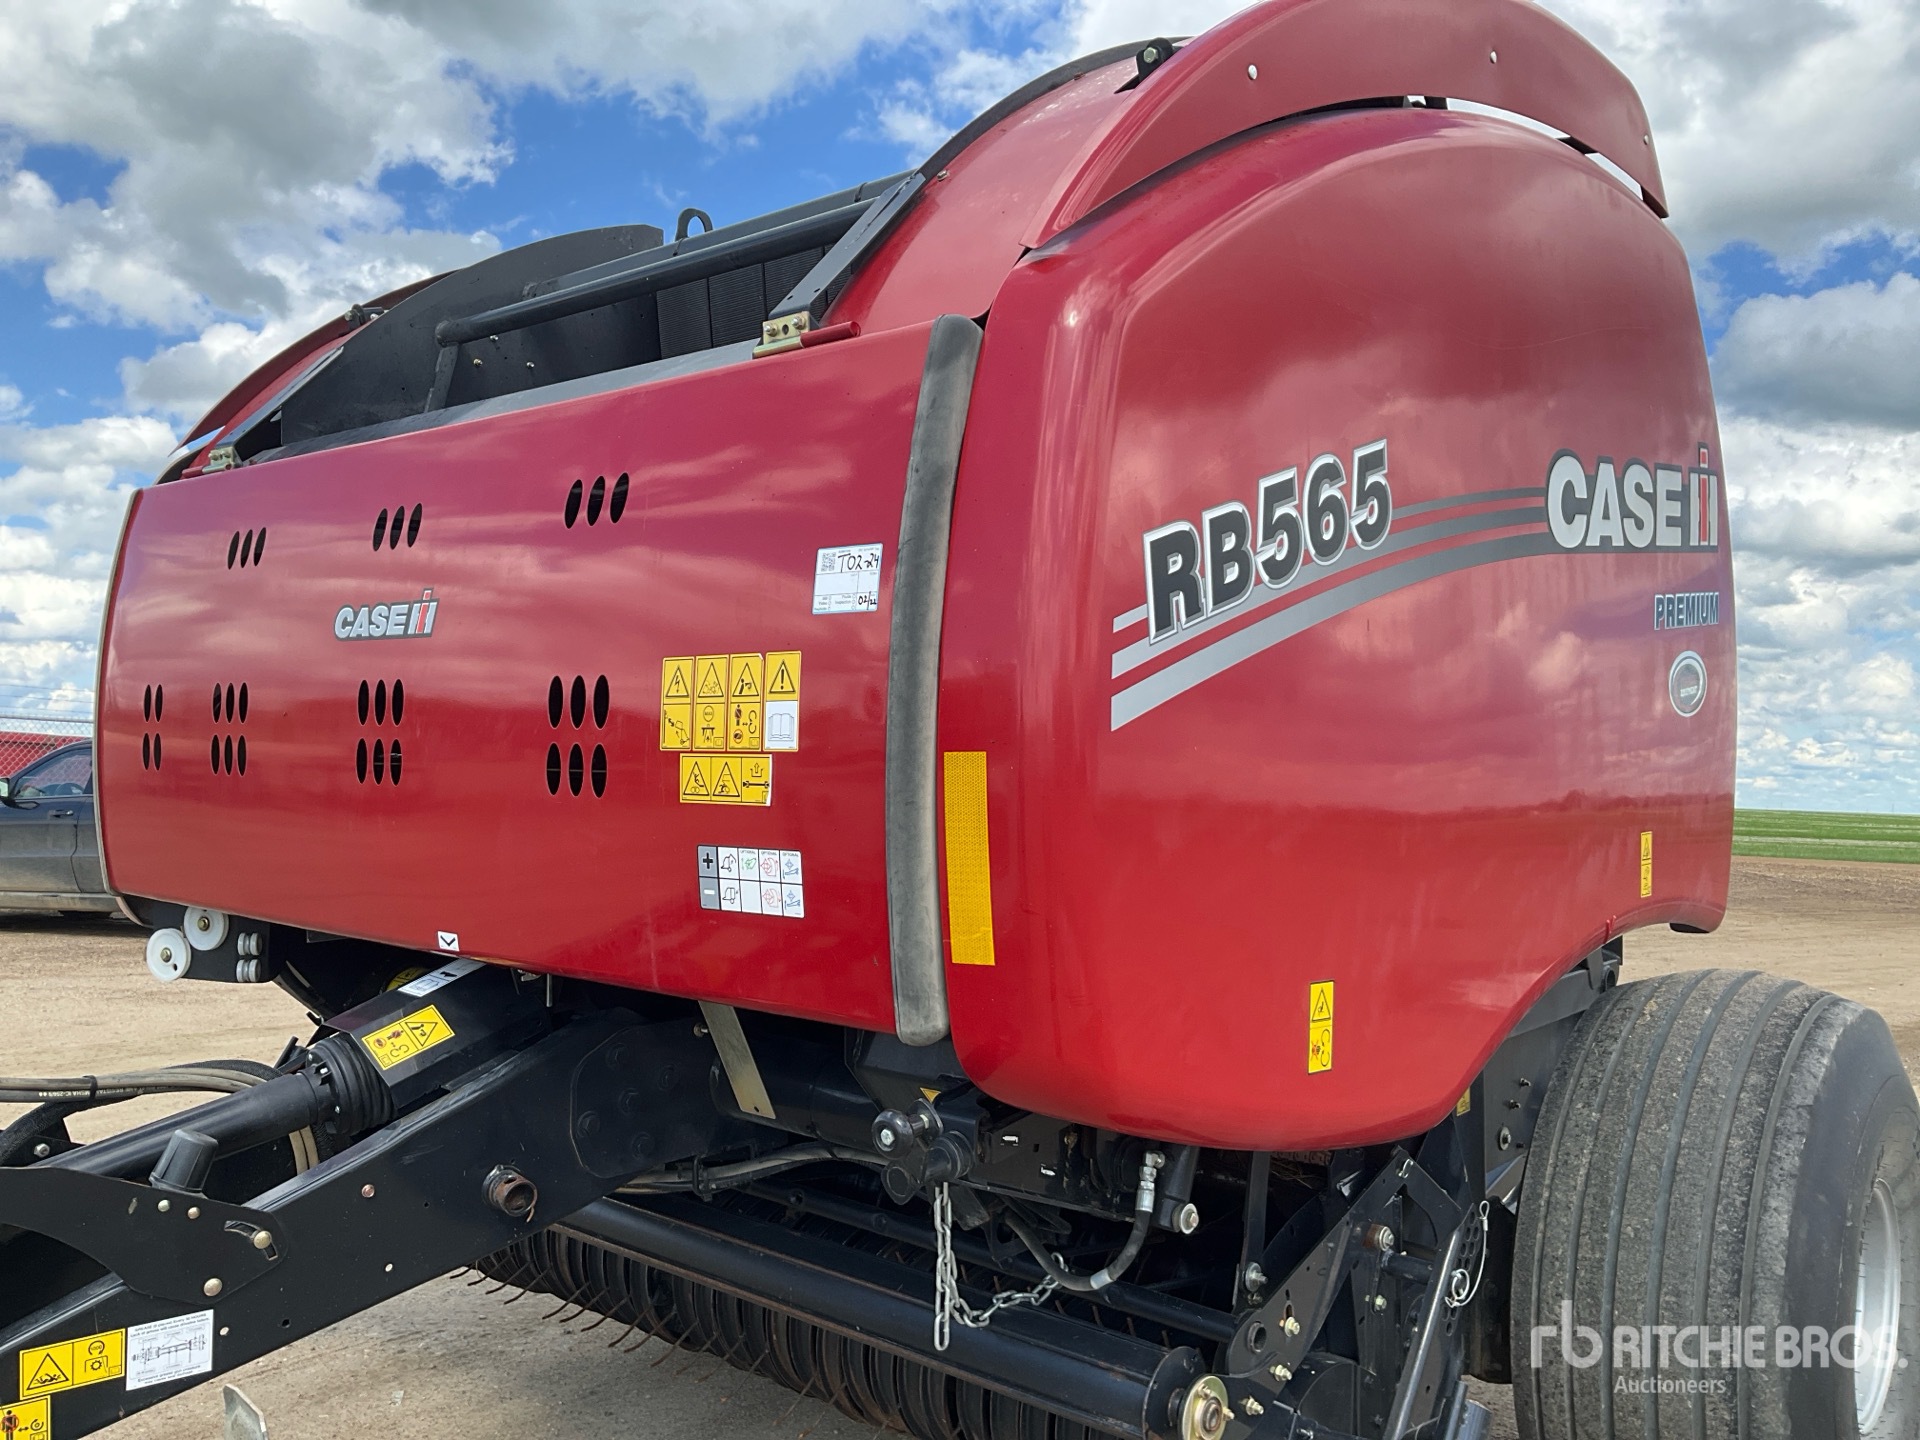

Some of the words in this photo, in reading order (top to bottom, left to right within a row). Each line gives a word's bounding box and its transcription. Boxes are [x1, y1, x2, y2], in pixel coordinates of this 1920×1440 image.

[1547, 449, 1682, 550] CASE
[1143, 438, 1392, 646] RB565
[334, 605, 409, 639] CASE
[1654, 592, 1719, 630] PREMIUM
